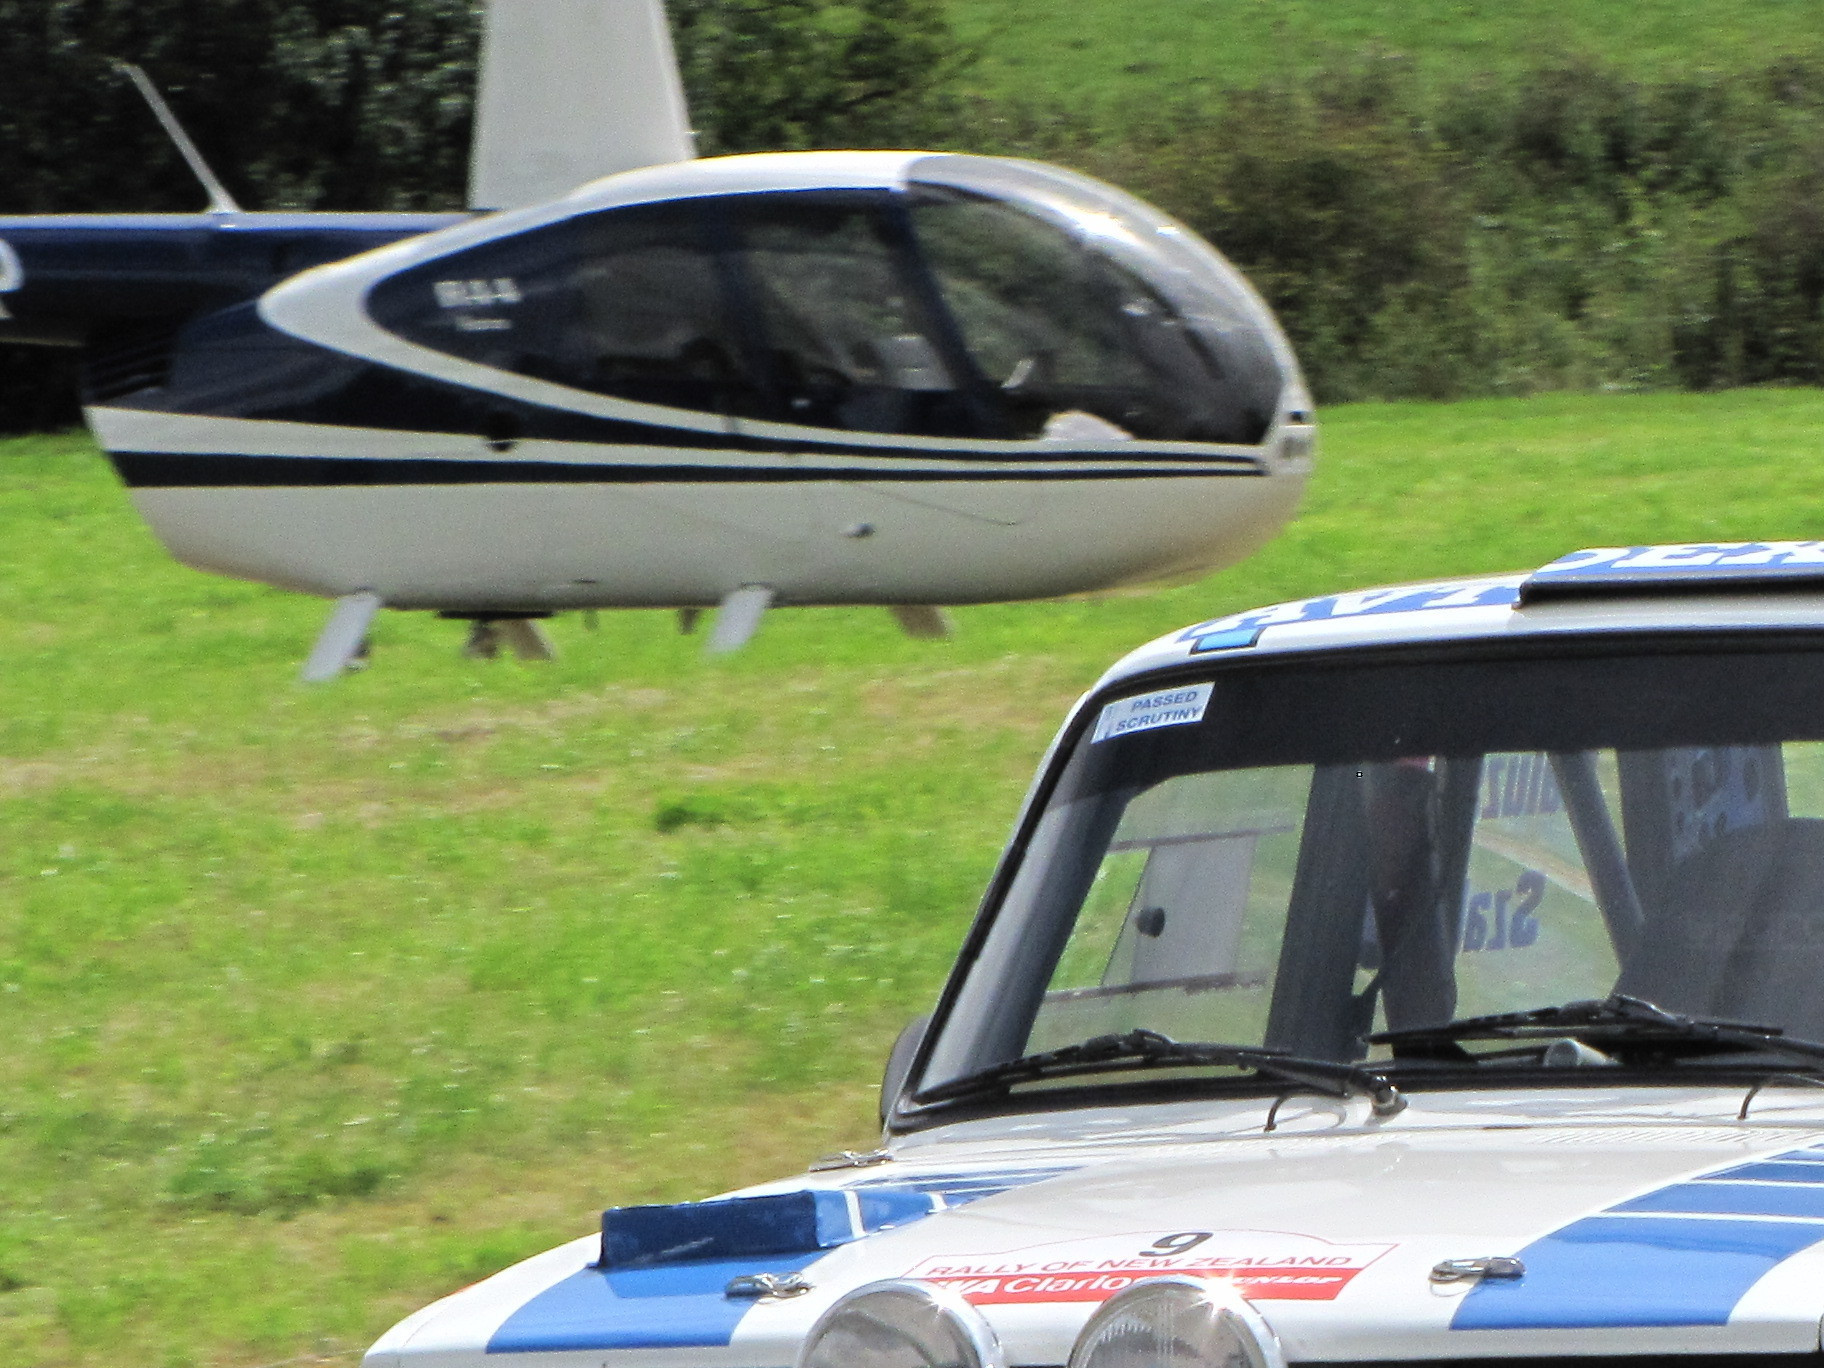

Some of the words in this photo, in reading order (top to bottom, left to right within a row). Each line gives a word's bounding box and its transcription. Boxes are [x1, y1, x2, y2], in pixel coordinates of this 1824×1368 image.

[1132, 691, 1197, 712] PASSED
[1116, 707, 1200, 732] SCRUTINY
[1138, 1232, 1214, 1256] 9
[926, 1262, 1035, 1275] RALLY
[1040, 1260, 1093, 1271] OF
[1098, 1256, 1187, 1270] NEW
[1185, 1256, 1352, 1267] ZEALAND
[1003, 1275, 1147, 1294] Clario
